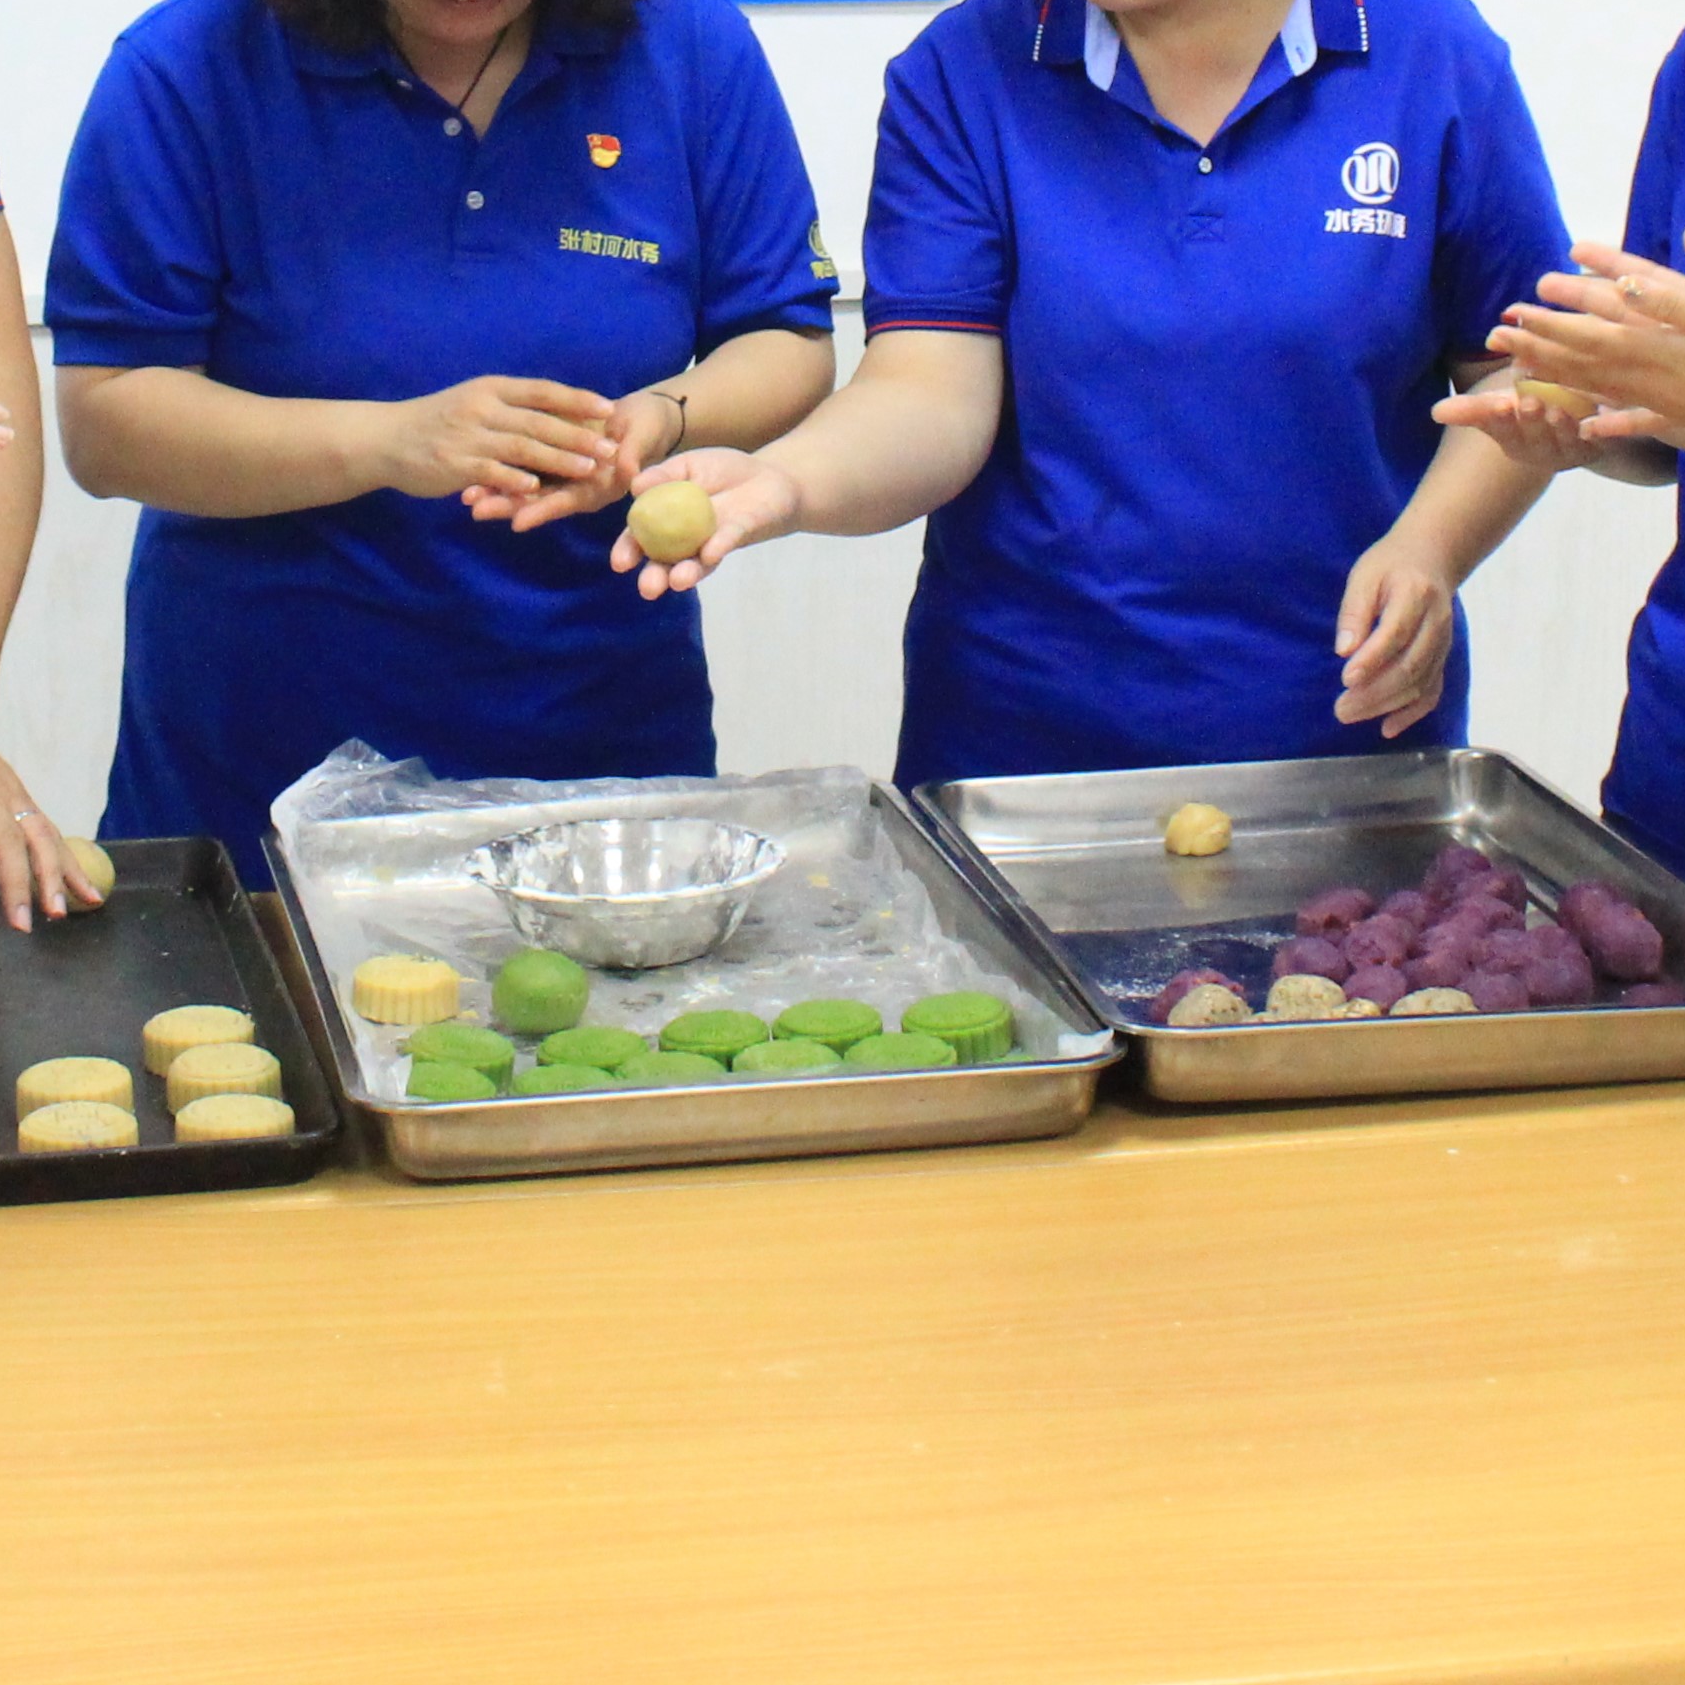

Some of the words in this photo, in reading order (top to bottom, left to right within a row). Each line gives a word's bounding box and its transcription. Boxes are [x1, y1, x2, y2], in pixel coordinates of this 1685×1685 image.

[559, 227, 661, 265] 张村河水务
